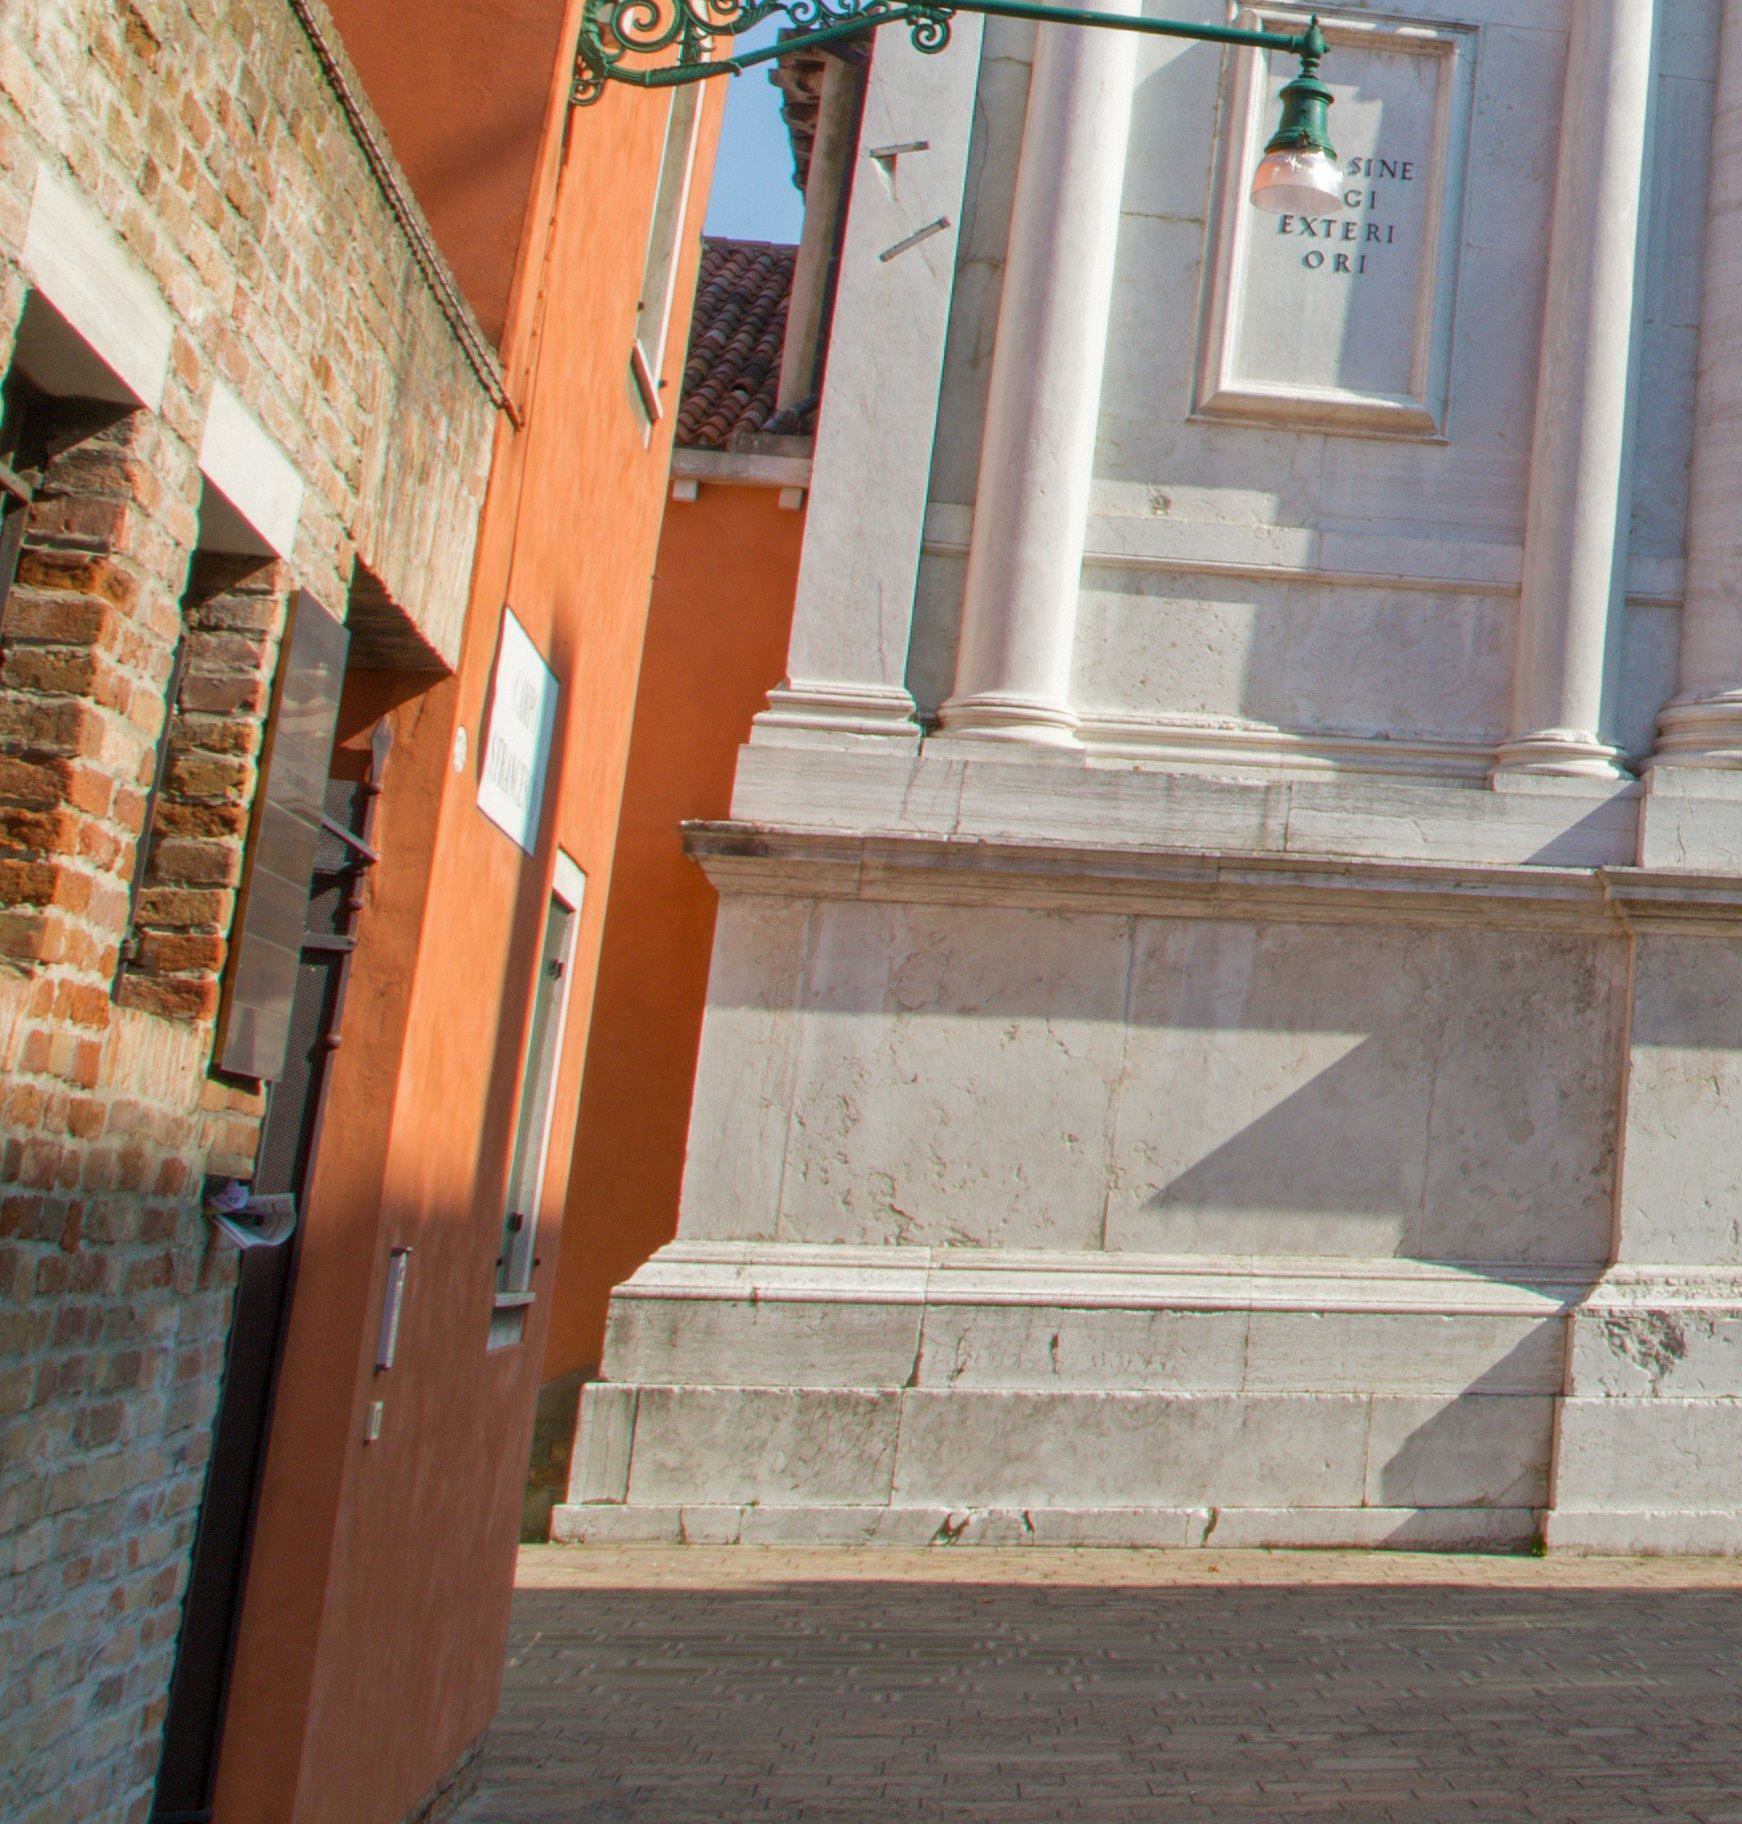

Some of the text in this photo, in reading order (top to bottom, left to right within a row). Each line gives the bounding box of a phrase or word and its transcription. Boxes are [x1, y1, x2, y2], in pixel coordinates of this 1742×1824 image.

[1347, 156, 1414, 181] SINE
[1343, 189, 1376, 209] GI
[1277, 214, 1395, 244] EXTERI
[1302, 250, 1367, 274] ORI
